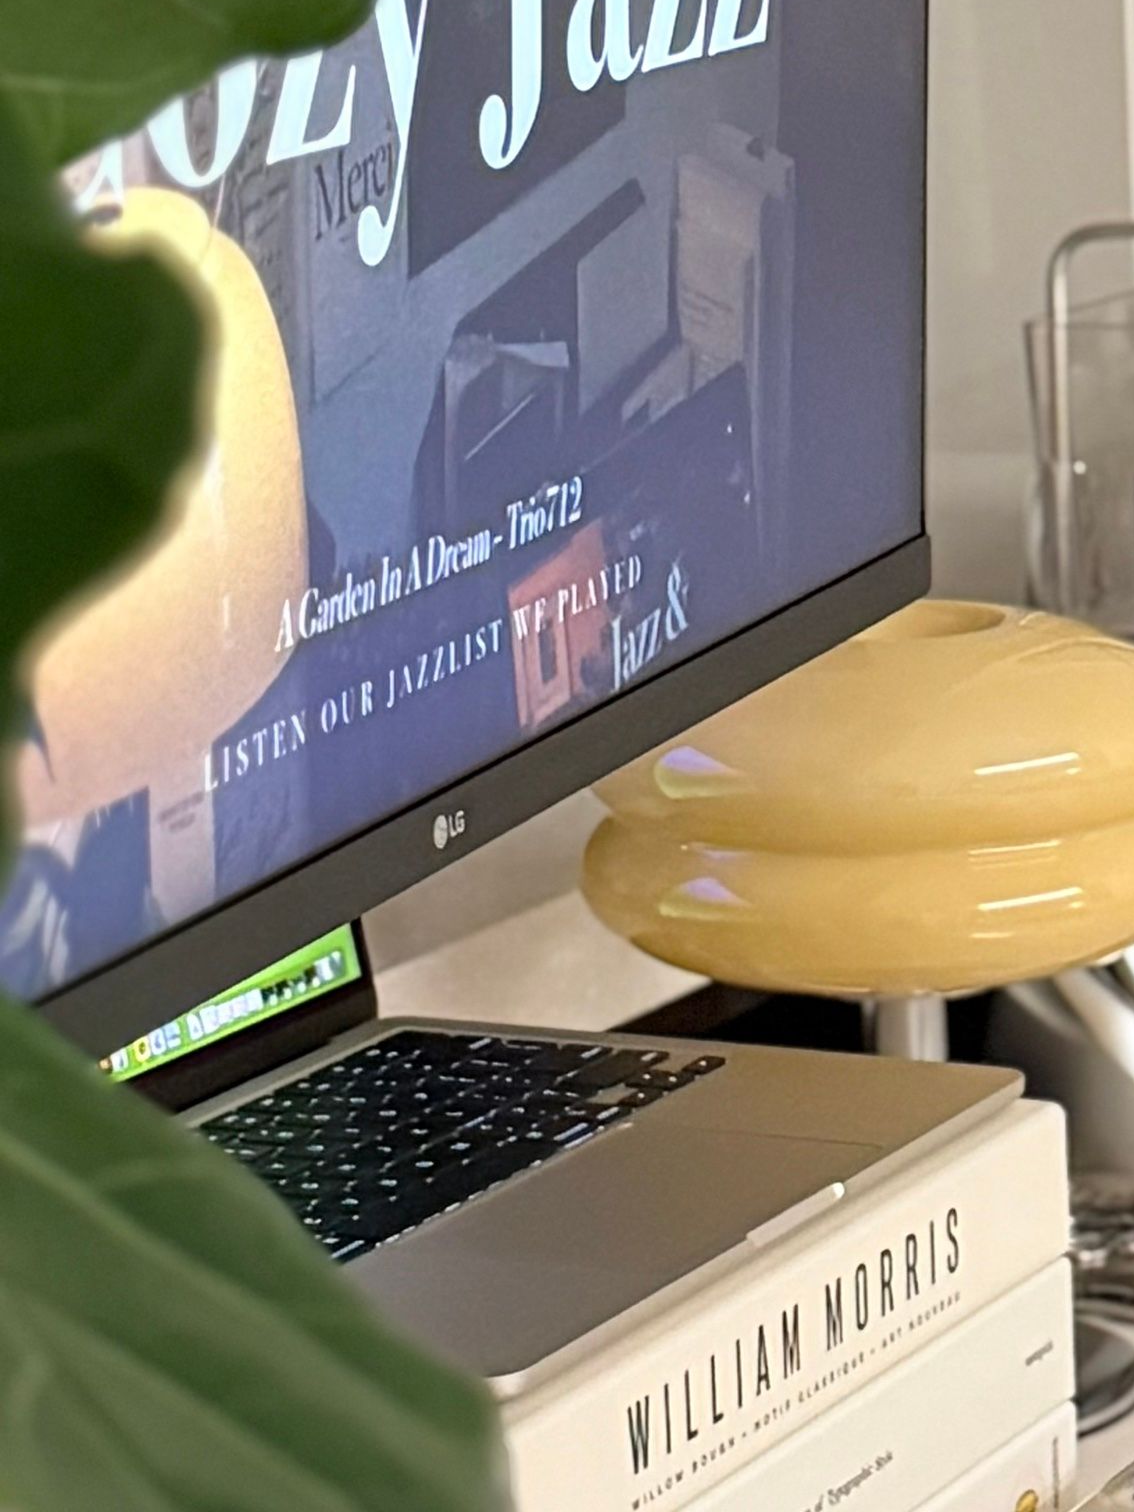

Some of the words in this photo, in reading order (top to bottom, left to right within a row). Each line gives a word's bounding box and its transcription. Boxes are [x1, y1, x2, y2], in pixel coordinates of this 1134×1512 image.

[274, 599, 295, 652] A
[299, 571, 376, 639] Garden
[380, 556, 401, 606] In
[405, 546, 422, 595] A
[426, 535, 491, 586] Dream
[507, 476, 583, 549] Trio712
[611, 607, 664, 694] Jazz
[665, 558, 691, 641] &
[204, 710, 308, 792] LISTEN
[320, 680, 375, 734] OUR
[386, 618, 503, 709] JAZZLIST
[512, 596, 547, 641] WE
[558, 554, 642, 624] PLAYED
[448, 809, 466, 838] LG
[627, 1304, 801, 1475] WILLIAM
[825, 1207, 959, 1352] MORRIS
